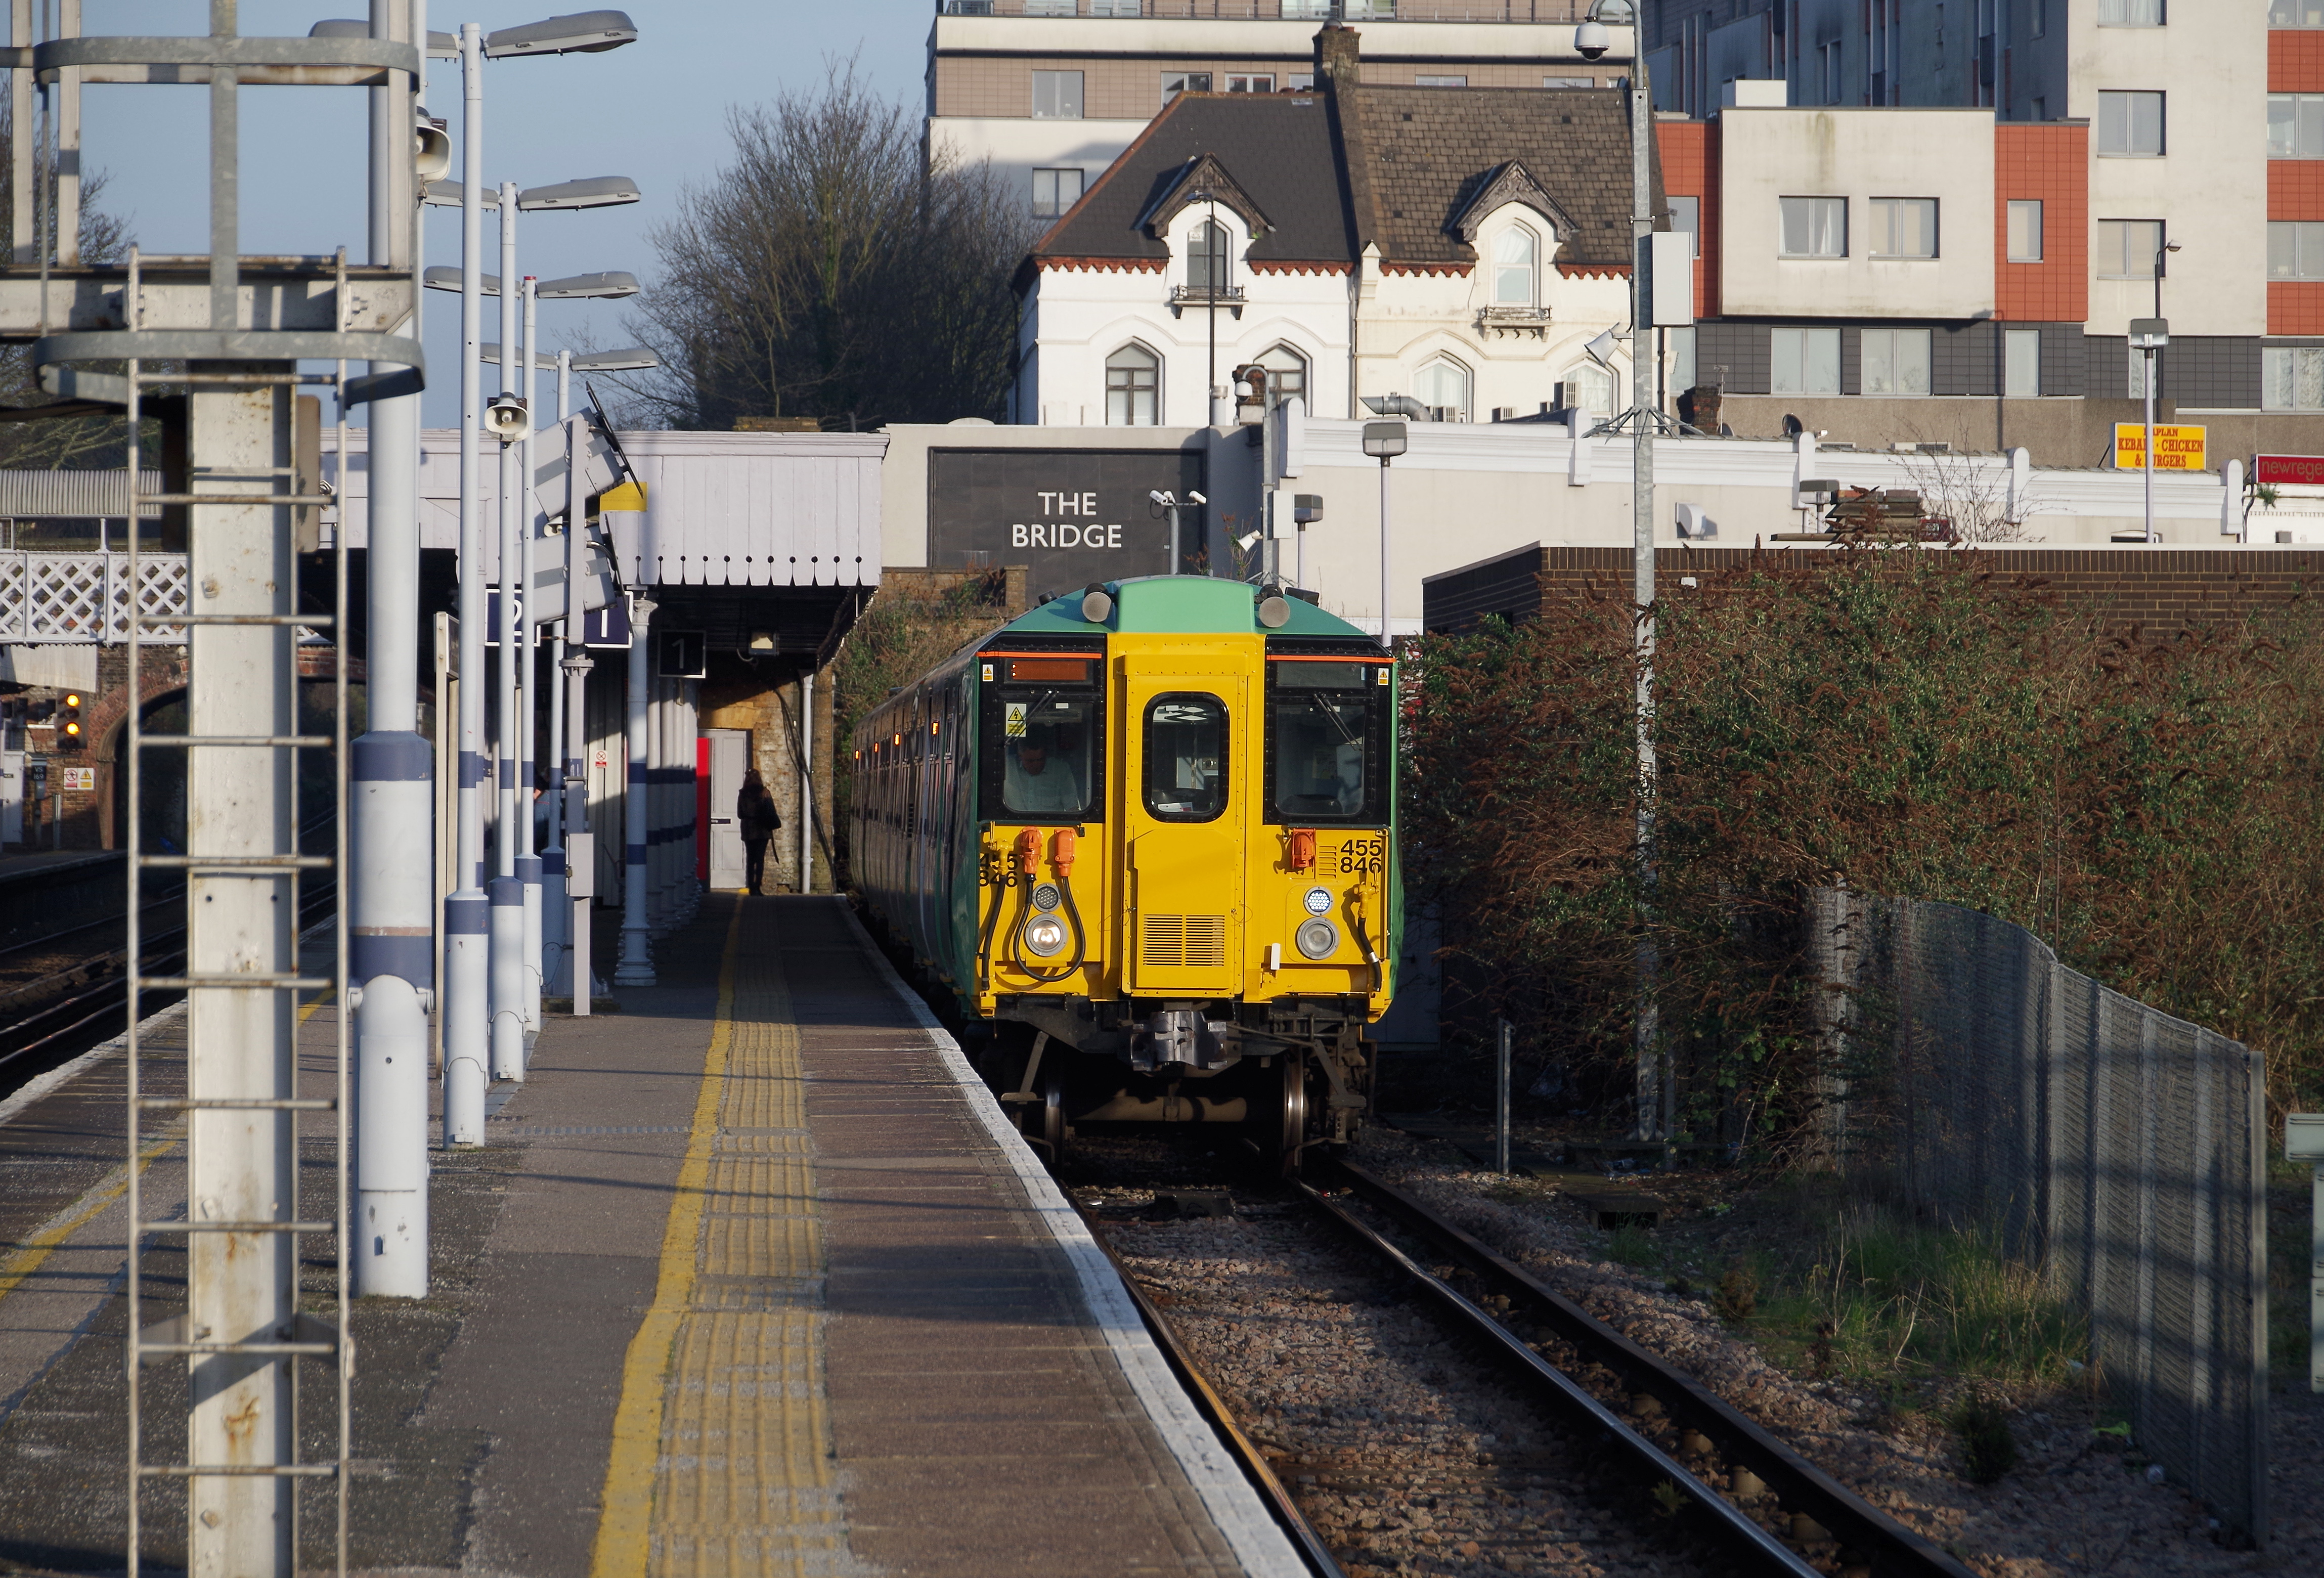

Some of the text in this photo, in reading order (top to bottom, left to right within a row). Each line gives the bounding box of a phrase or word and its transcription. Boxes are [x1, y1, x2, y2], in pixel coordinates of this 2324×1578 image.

[2161, 439, 2204, 453] CHICKEN
[2134, 453, 2186, 467] & URGERS
[2261, 461, 2324, 481] newrege
[1038, 492, 1097, 515] THE
[1013, 524, 1122, 548] BRIDGE
[672, 638, 685, 669] 1
[1340, 839, 1382, 856] 455
[1340, 856, 1382, 874] 846
